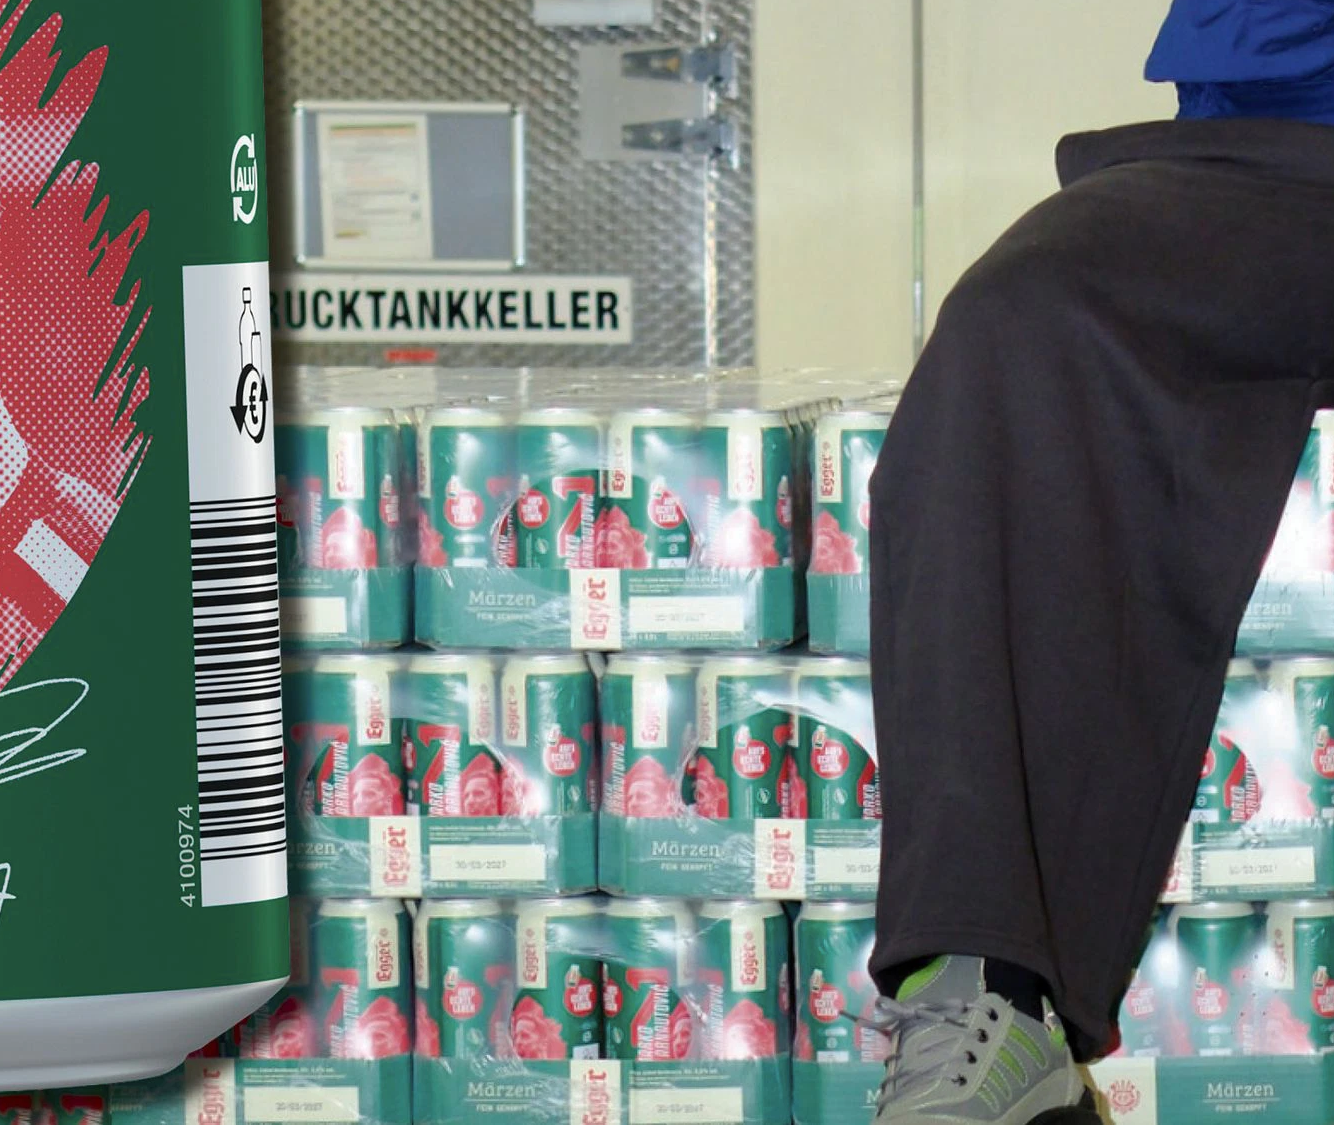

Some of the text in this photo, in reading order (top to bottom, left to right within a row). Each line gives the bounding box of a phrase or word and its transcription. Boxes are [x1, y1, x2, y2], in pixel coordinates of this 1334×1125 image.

[236, 166, 255, 192] ALU
[468, 589, 537, 607] Märzen
[178, 804, 196, 908] 4100974
[652, 840, 719, 858] Märzen
[376, 939, 392, 983] Egger
[467, 1081, 537, 1098] Märzen
[1207, 1082, 1276, 1099] Märzen
